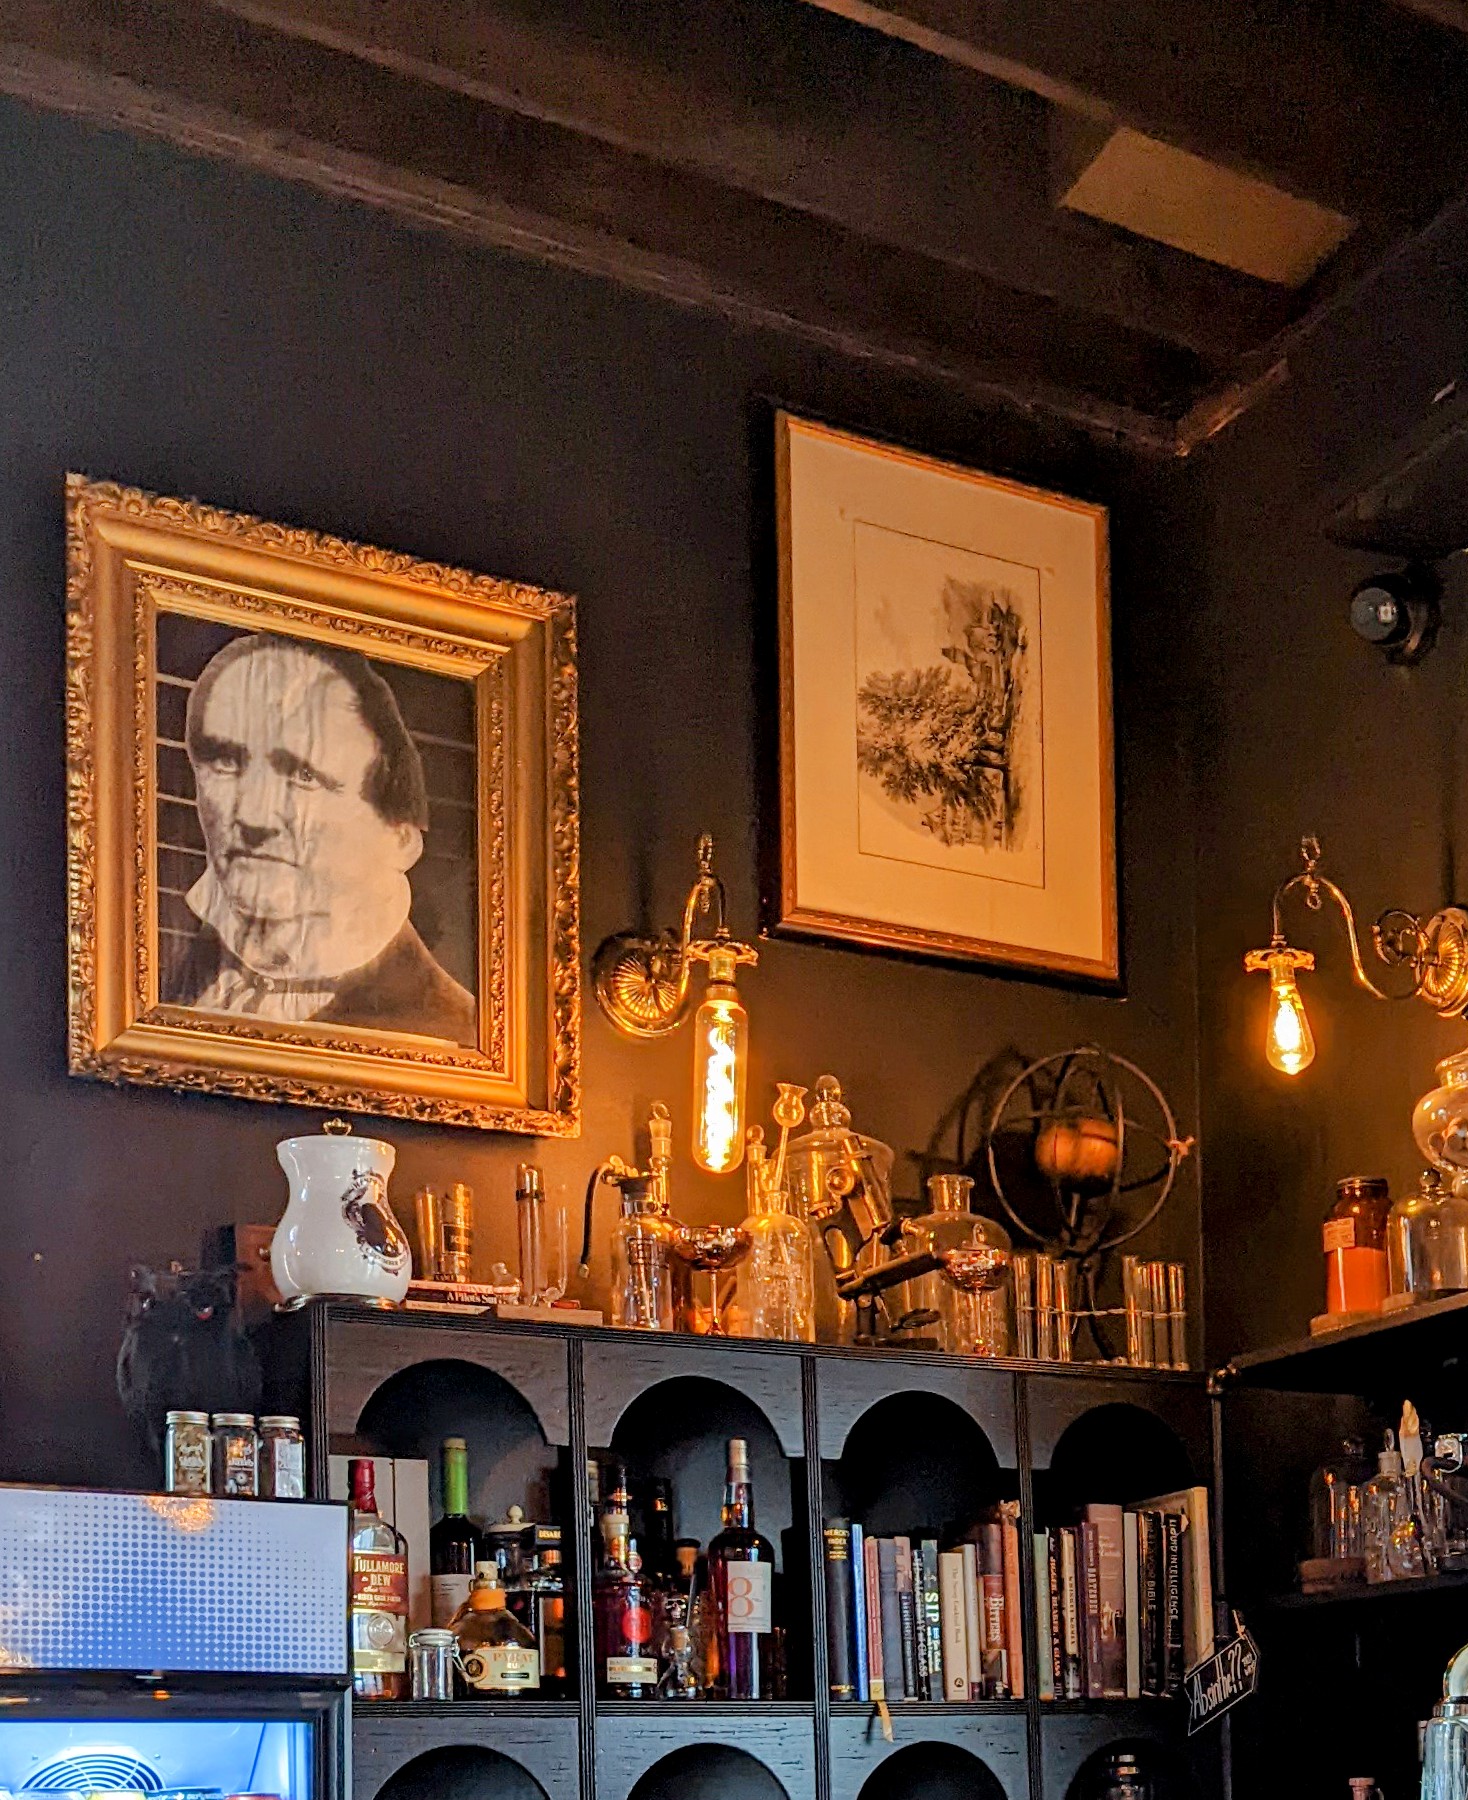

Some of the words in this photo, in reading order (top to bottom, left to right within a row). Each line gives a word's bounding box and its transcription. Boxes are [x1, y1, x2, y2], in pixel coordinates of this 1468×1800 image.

[354, 1556, 404, 1574] TULLAMORE
[370, 1574, 391, 1586] DEW
[728, 1577, 754, 1617] 8
[1169, 1553, 1179, 1619] INTELLIGENCE
[925, 1592, 940, 1623] SIP
